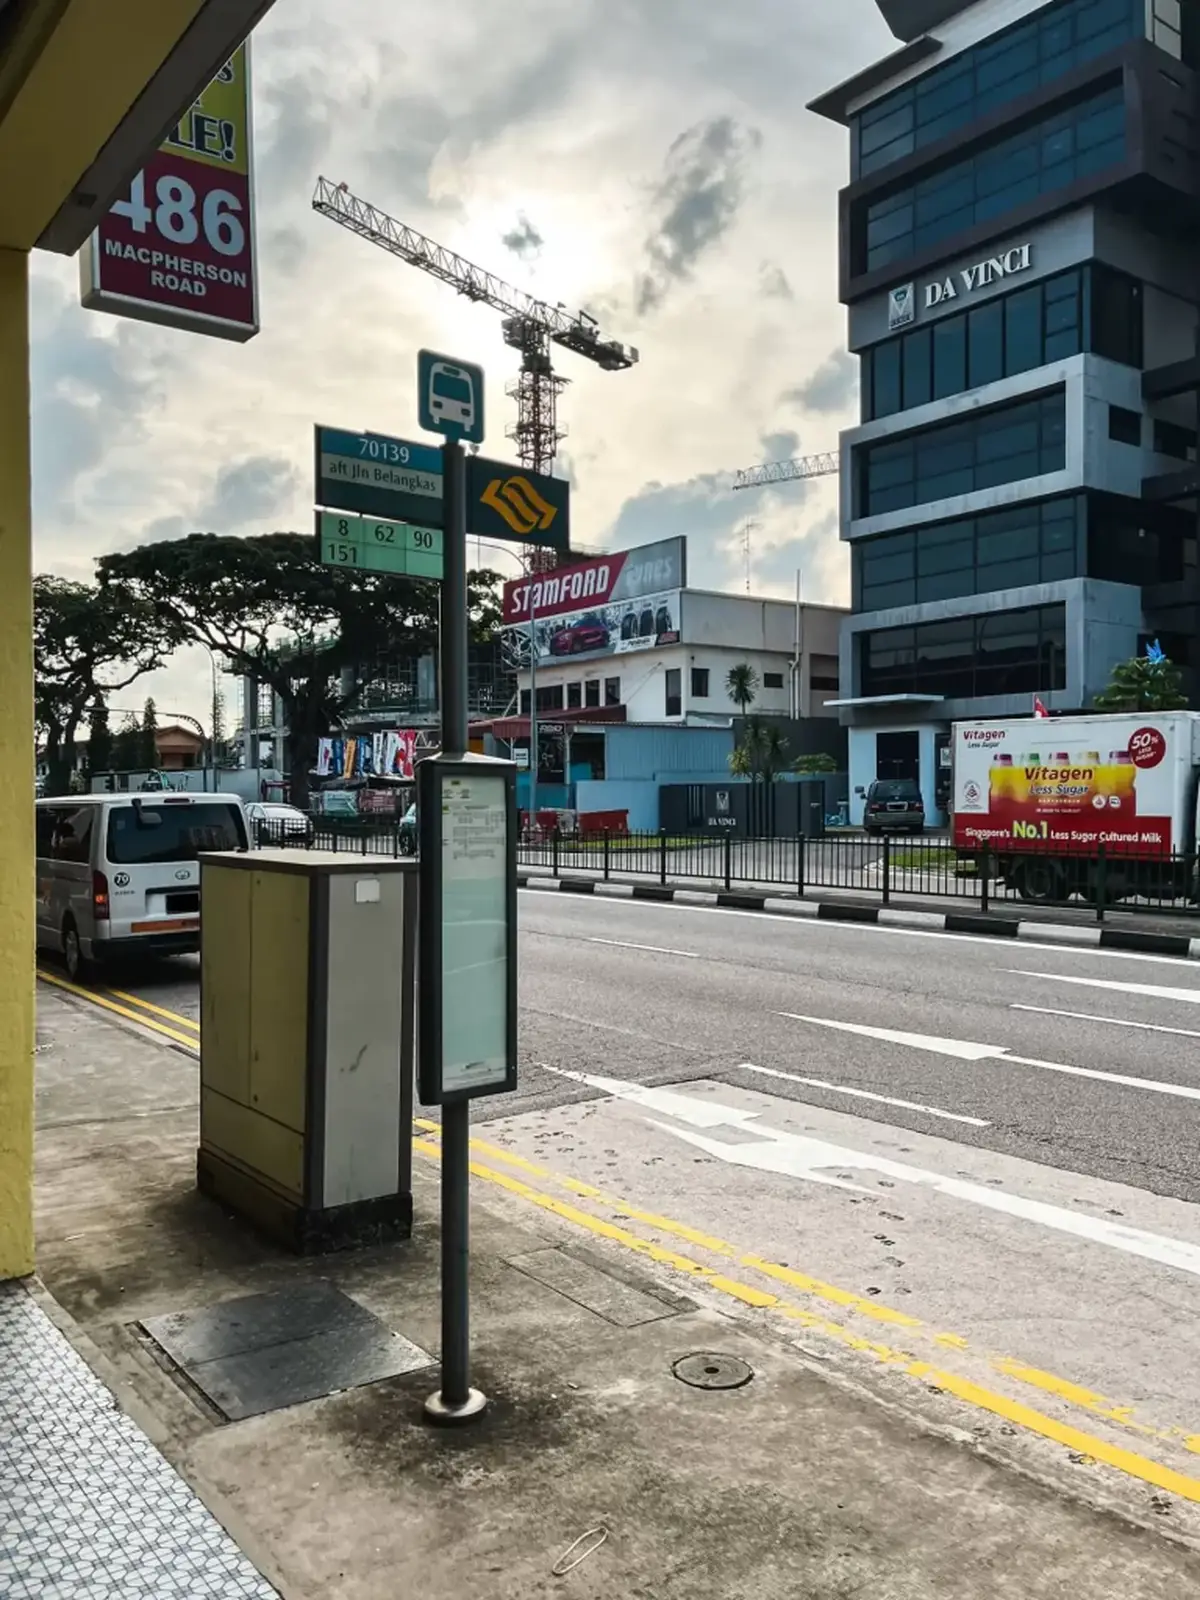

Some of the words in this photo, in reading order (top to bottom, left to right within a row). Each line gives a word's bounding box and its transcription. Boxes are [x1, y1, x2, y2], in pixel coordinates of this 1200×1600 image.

[109, 168, 245, 256] 486
[105, 239, 247, 287] MACPHERSON
[925, 277, 957, 308] DA
[960, 243, 1031, 291] VINCI
[151, 271, 206, 297] ROAD
[359, 438, 410, 464] 70139
[329, 460, 348, 475] aft
[351, 463, 370, 480] Jln
[374, 468, 436, 492] Belangkas
[338, 519, 349, 536] 8
[374, 524, 395, 544] 62
[414, 530, 433, 548] 90
[327, 543, 358, 564] 151
[963, 730, 1006, 741] Vitagen
[1131, 733, 1159, 749] 50%
[1025, 767, 1093, 783] Vitagen
[1029, 784, 1053, 794] Less
[1056, 783, 1089, 795] Sugar
[1012, 819, 1048, 839] No.1
[1050, 829, 1069, 840] Less
[1071, 830, 1097, 843] Sugar
[1099, 831, 1139, 843] Cultured
[1140, 832, 1162, 843] Milk
